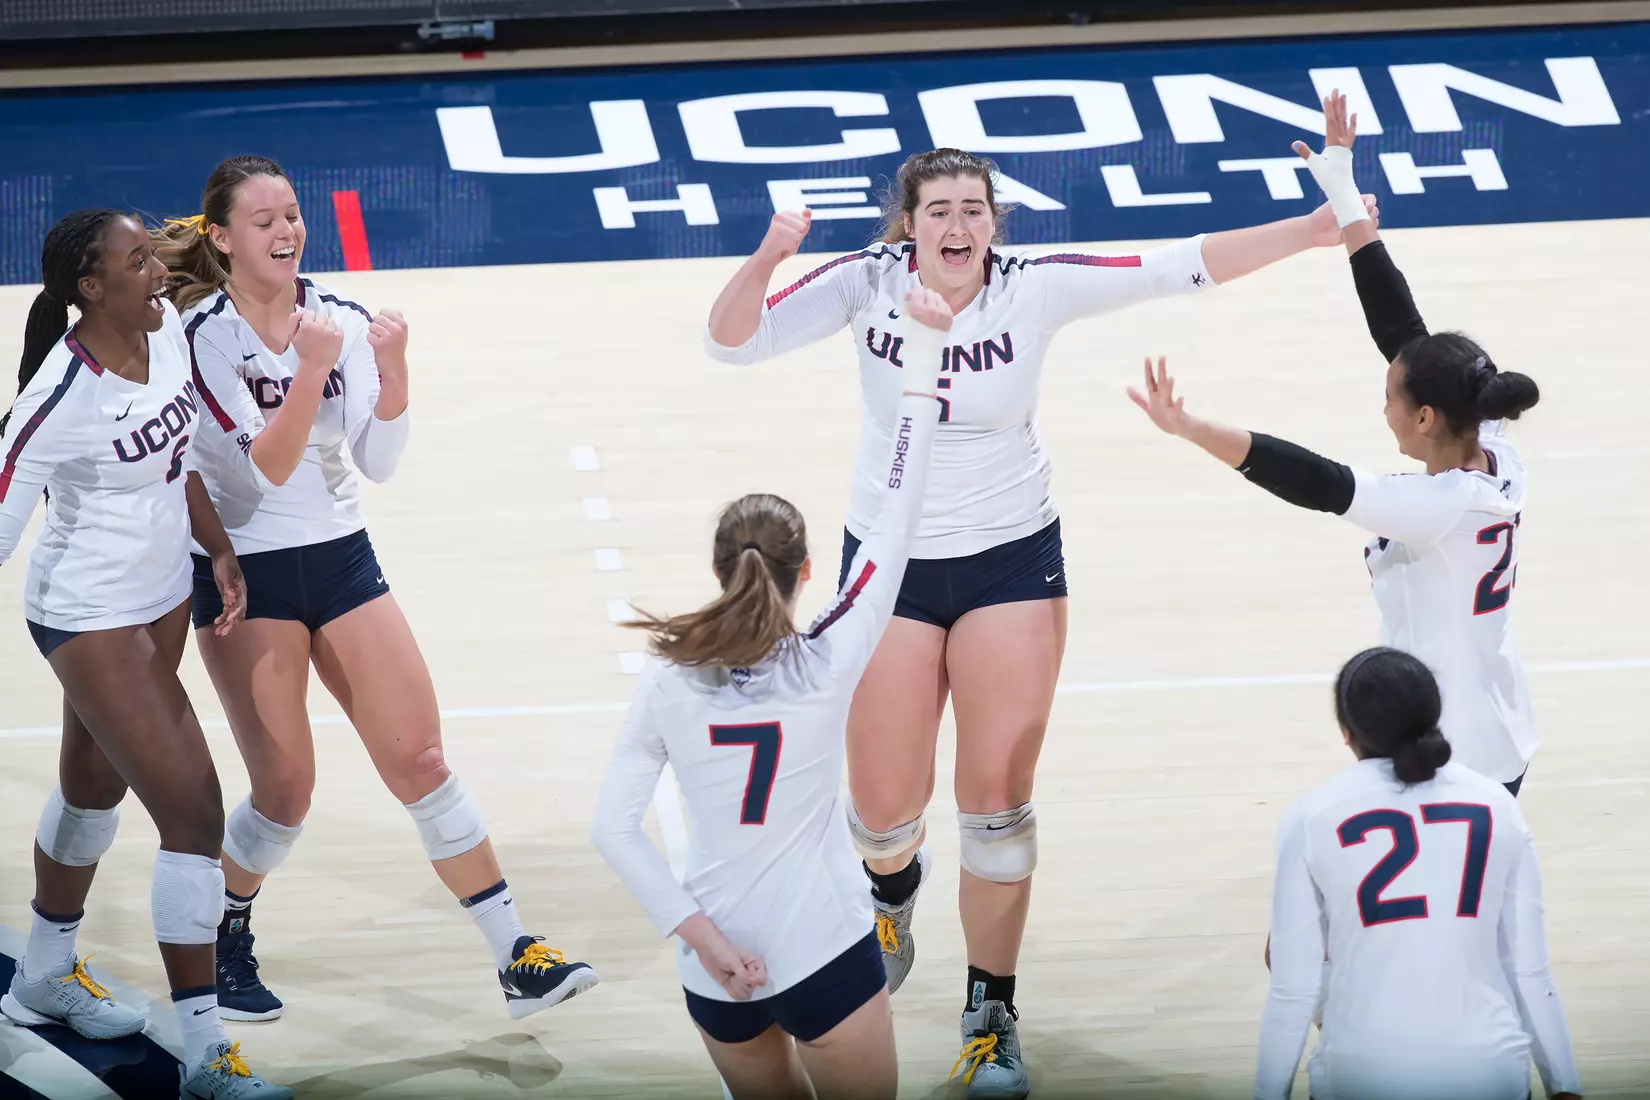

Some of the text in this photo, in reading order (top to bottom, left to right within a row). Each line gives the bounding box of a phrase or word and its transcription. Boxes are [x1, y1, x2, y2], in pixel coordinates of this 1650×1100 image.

[435, 56, 1621, 174] UCONN
[888, 416, 913, 490] HUSKIES
[1473, 510, 1520, 616] 2
[708, 720, 783, 826] 7
[1336, 801, 1493, 928] 27
